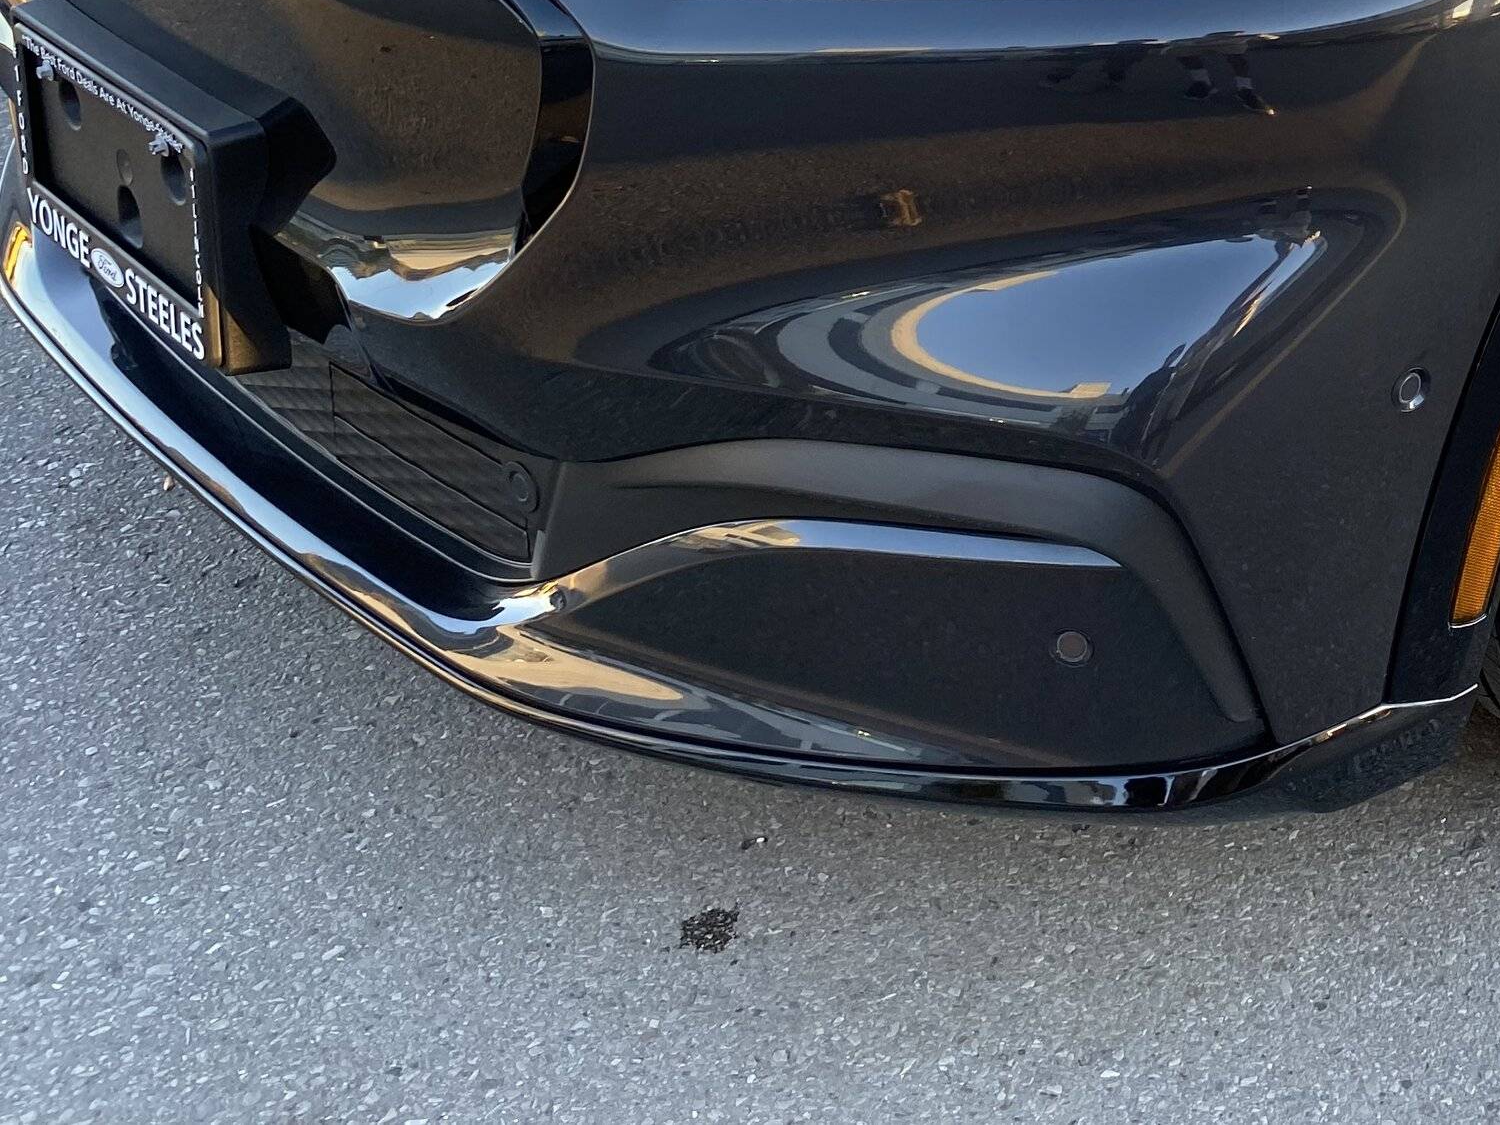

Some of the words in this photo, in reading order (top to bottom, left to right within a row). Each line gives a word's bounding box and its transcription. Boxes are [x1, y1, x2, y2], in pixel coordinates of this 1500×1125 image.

[57, 58, 76, 80] Ford
[100, 87, 115, 106] Are
[116, 98, 127, 114] At
[27, 187, 91, 269] YONGE
[124, 268, 205, 360] STEELES
